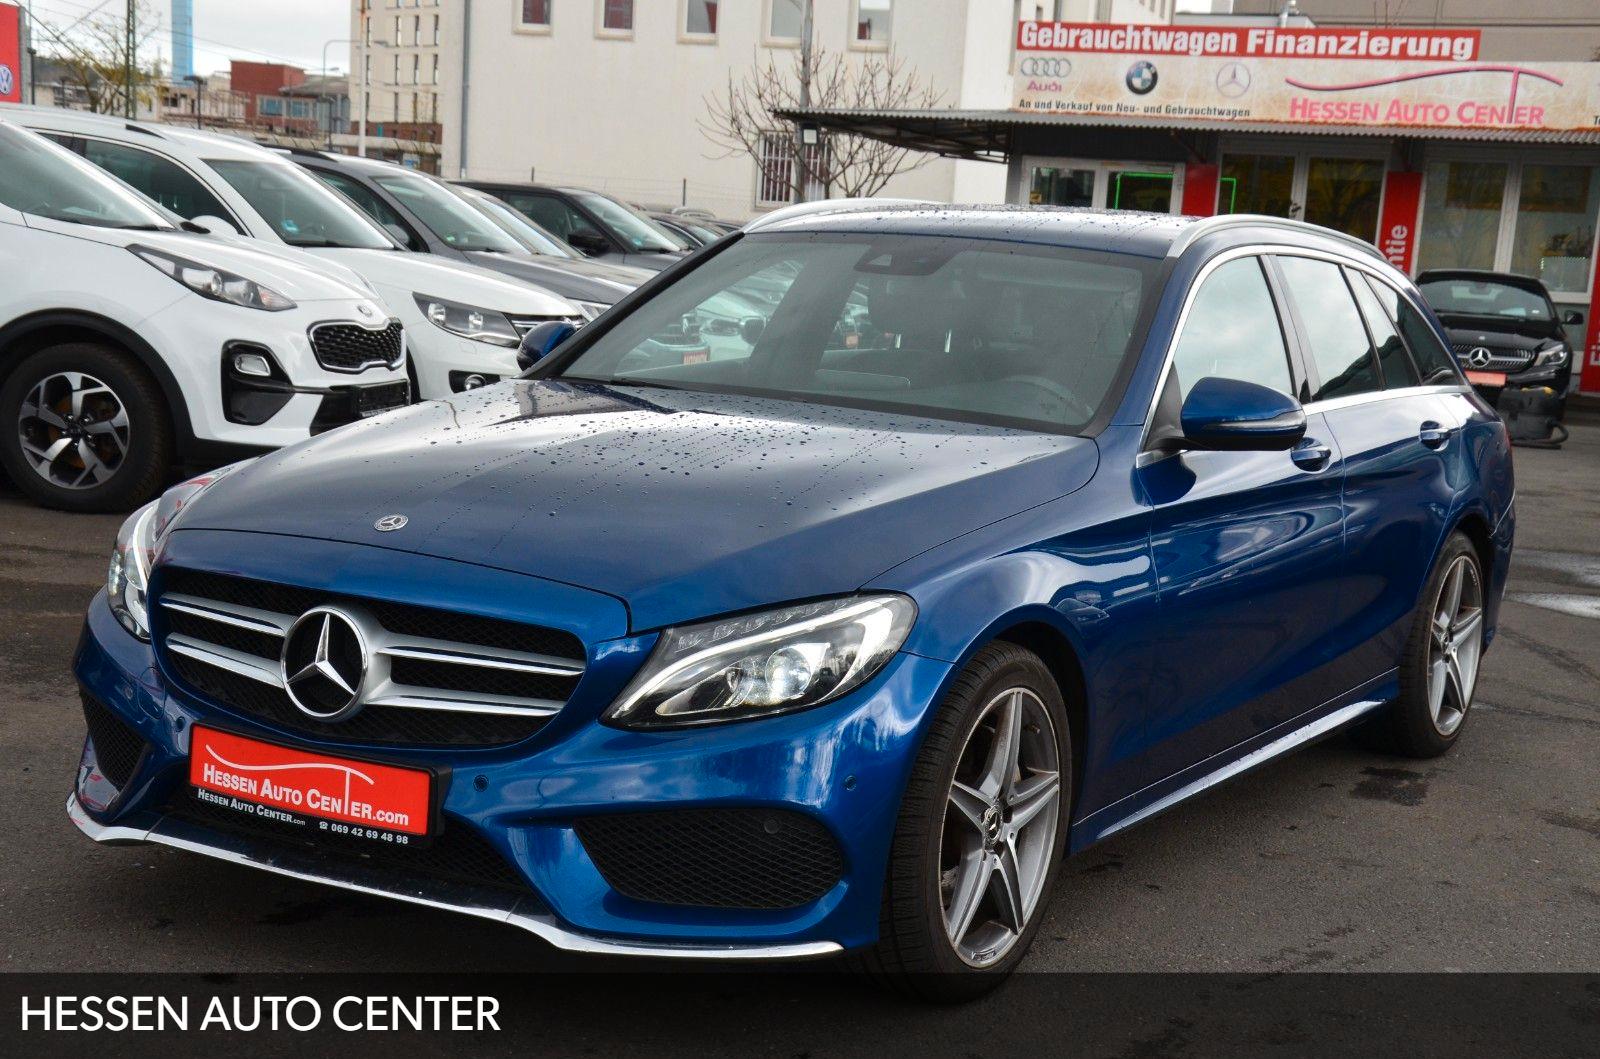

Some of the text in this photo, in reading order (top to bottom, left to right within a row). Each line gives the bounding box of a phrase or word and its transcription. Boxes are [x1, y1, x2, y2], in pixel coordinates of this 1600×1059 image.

[1021, 22, 1474, 61] Gebrauchtwagen Finanzierung
[1019, 99, 1031, 108] An
[1034, 101, 1052, 109] und
[1055, 102, 1093, 111] Verkauf
[1095, 104, 1113, 112] von
[1143, 105, 1162, 114] und
[1165, 105, 1250, 119] Gebrauchtwagen
[1290, 98, 1378, 121] HESSEN
[1384, 99, 1450, 124] AUTO
[203, 763, 257, 795] HESSEN
[260, 778, 303, 806] AUTO
[198, 788, 306, 827] HESSEN AUTO CENTER.com
[330, 822, 409, 845] 069 42 69 48 98
